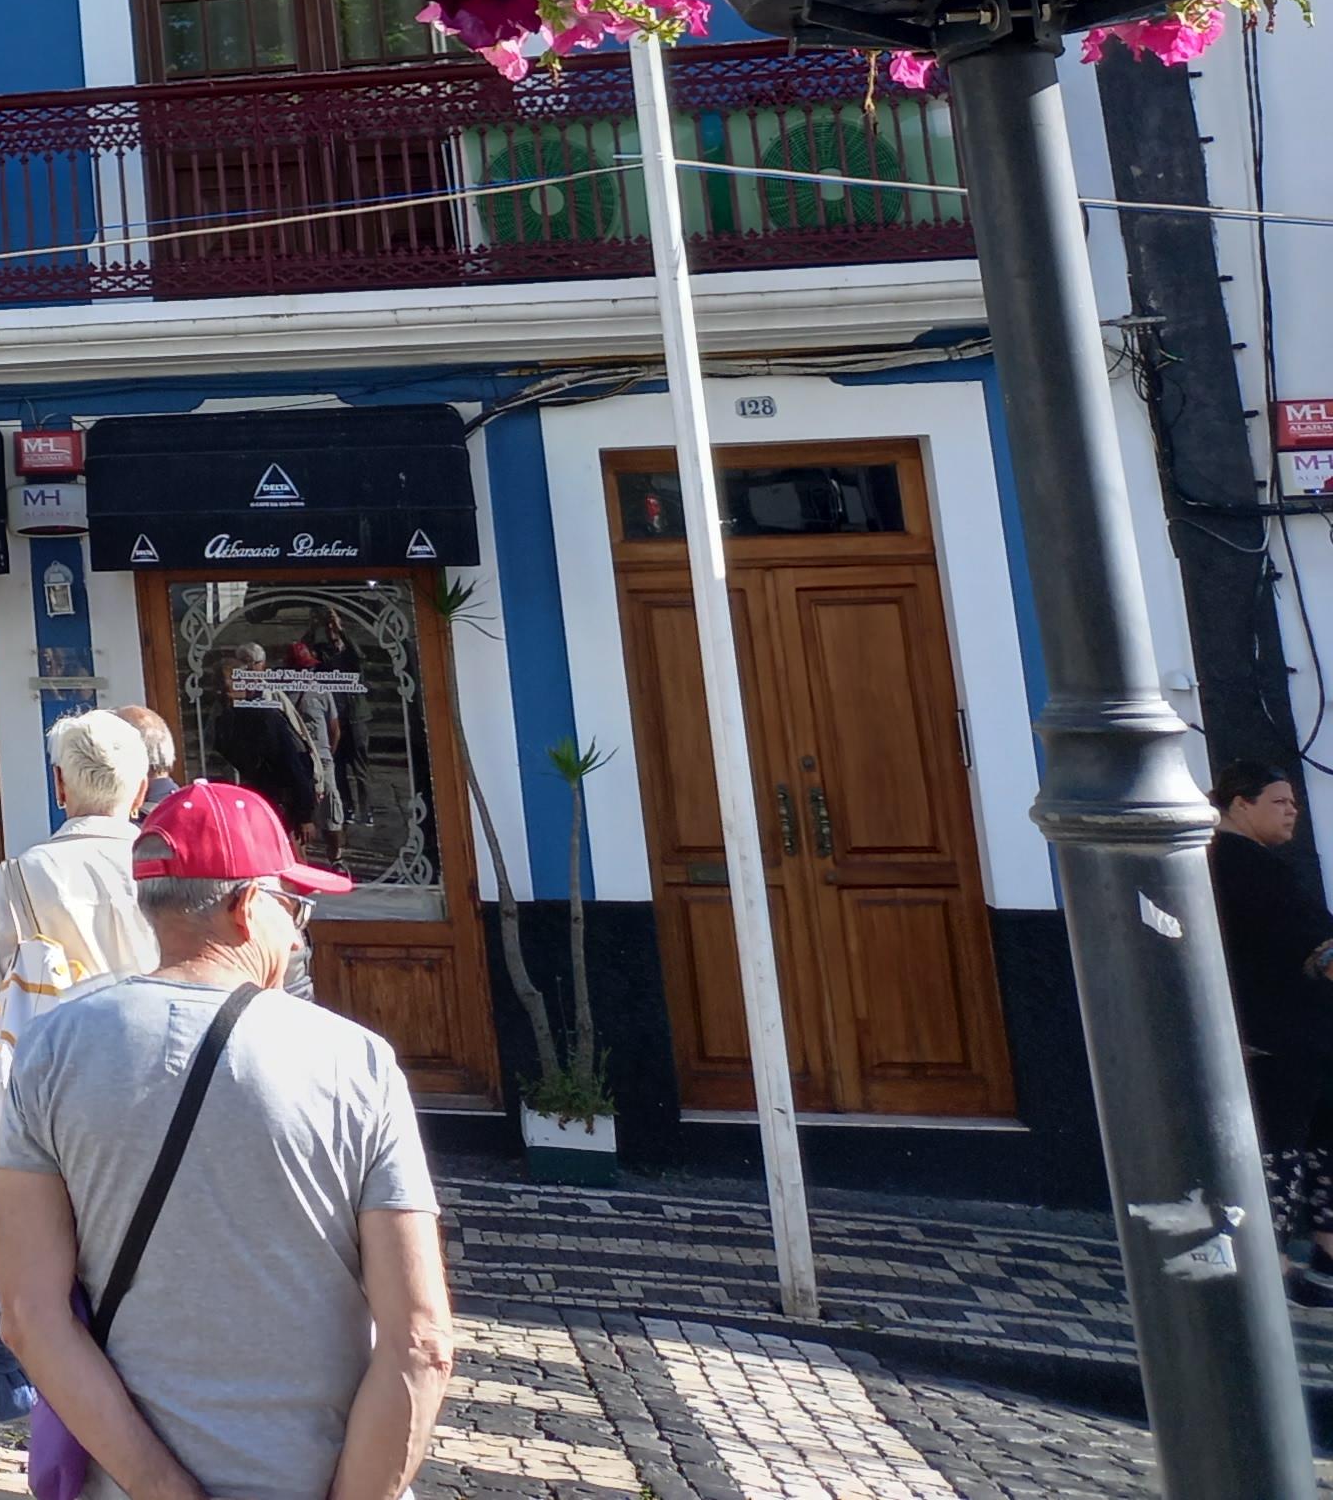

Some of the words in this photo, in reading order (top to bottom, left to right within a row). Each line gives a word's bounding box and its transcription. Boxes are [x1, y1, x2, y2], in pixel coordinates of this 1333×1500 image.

[740, 399, 774, 416] 128
[204, 533, 281, 558] Athanasio
[286, 532, 359, 557] Pastelaria
